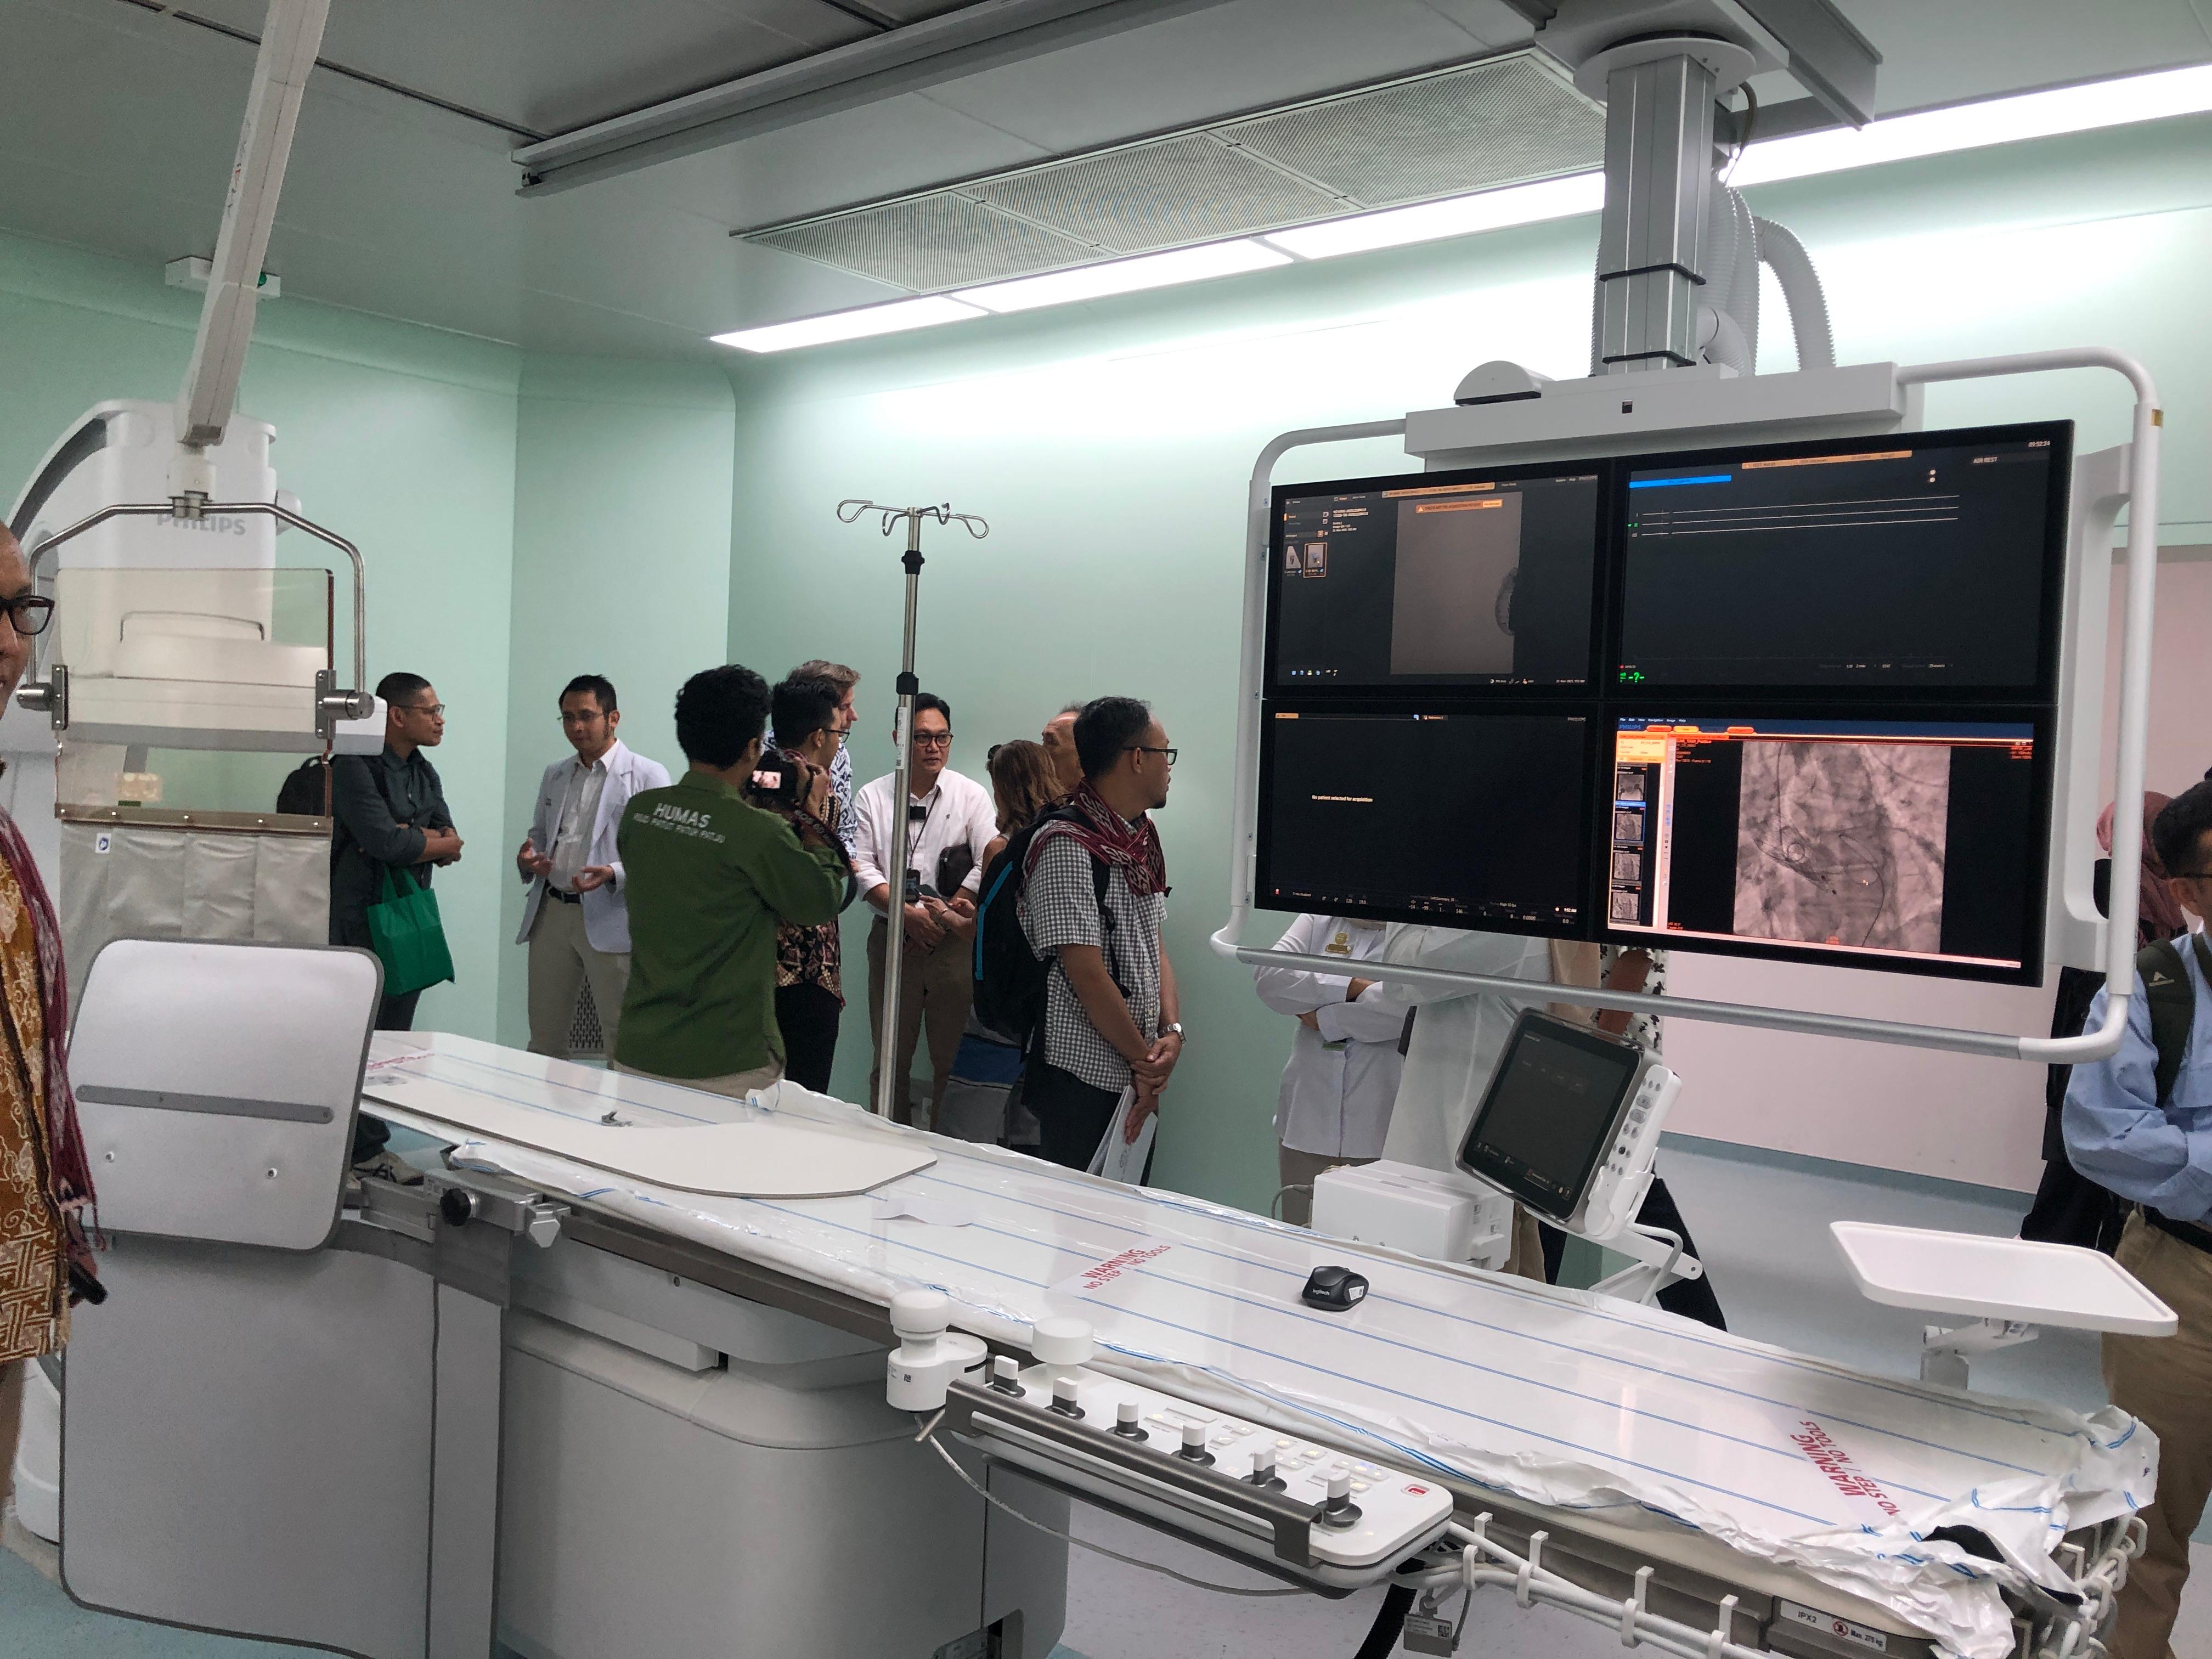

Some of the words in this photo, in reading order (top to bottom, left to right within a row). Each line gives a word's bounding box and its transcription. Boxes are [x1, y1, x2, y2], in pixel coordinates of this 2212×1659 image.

[653, 803, 712, 828] HUMAS
[1081, 1249, 1146, 1279] WARNING
[1082, 1281, 1103, 1290] NO
[1098, 1270, 1122, 1282] STEP
[1126, 1257, 1146, 1266] NO
[1144, 1245, 1171, 1259] TOOLS
[1799, 1421, 1836, 1447] TOOLS
[1790, 1434, 1867, 1497] WARNING
[1828, 1449, 1853, 1464] NO
[1853, 1475, 1887, 1499] STEP
[1798, 1611, 1817, 1624] IPX2
